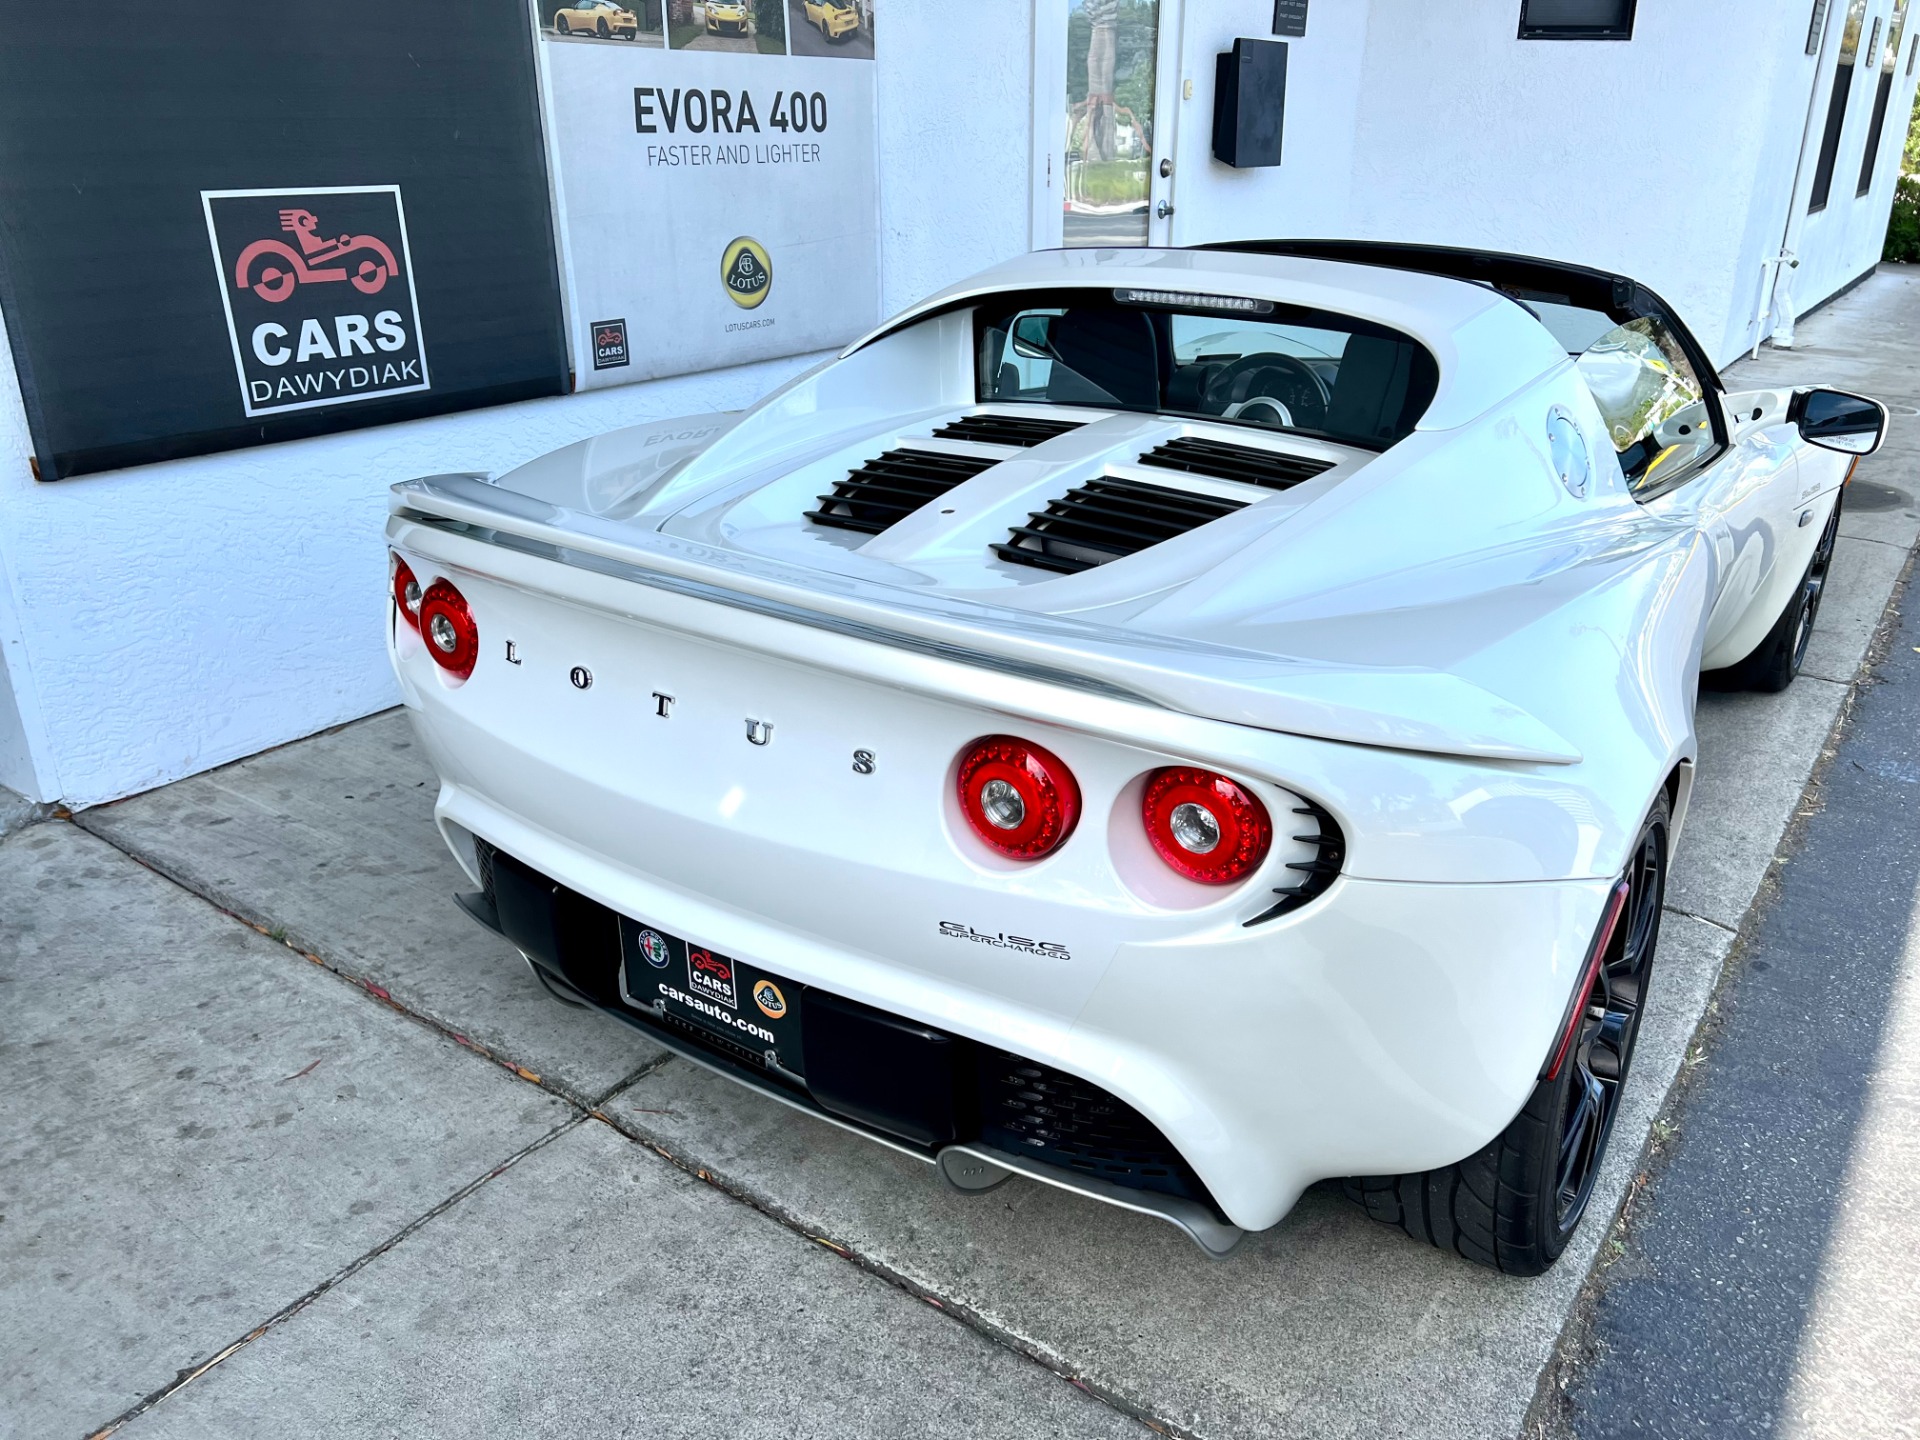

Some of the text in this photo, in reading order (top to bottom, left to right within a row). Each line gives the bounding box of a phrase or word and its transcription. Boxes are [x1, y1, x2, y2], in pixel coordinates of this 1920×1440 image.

[634, 87, 827, 133] EVORA 400
[647, 144, 821, 166] FASTER AND LIGHTER
[729, 272, 765, 289] LOTUS
[251, 310, 406, 367] CARS
[725, 318, 775, 333] LOTUSCARS.COM
[598, 346, 624, 357] CARS
[250, 359, 420, 402] DAWYDIAK
[505, 639, 877, 775] LOTUS
[938, 920, 1071, 954] ELISE
[938, 928, 1072, 961] SUPERCHARGED
[690, 981, 735, 1006] DAWYDIAK
[692, 970, 732, 996] CARS
[658, 983, 775, 1044] carsauto.com
[757, 993, 783, 1010] LOTUS
